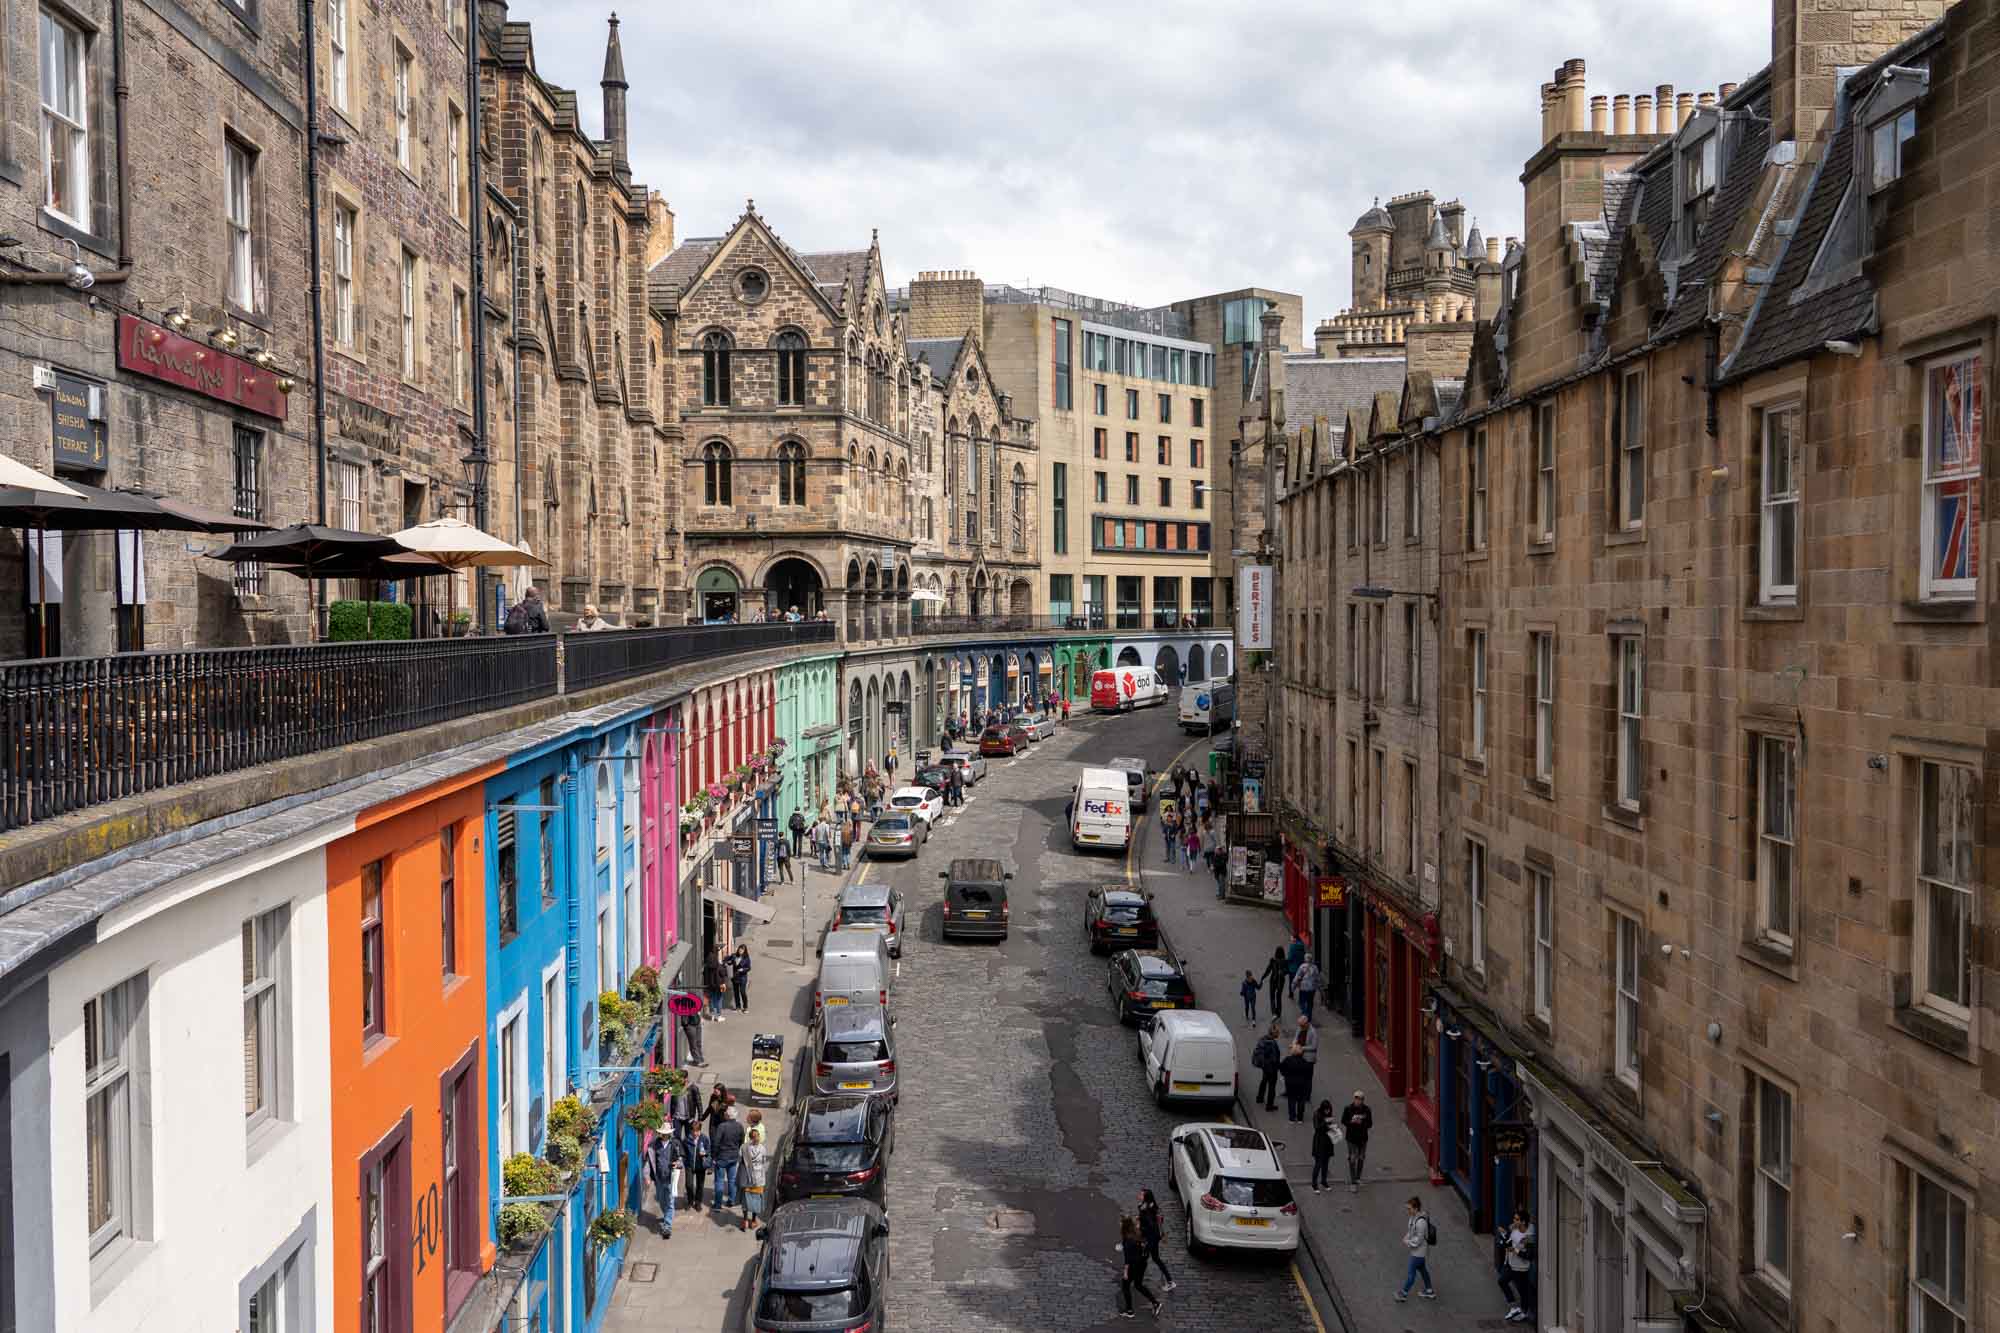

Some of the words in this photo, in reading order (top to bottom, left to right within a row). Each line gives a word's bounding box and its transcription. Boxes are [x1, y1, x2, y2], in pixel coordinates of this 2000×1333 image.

[57, 412, 86, 431] SHISHA
[57, 435, 89, 453] TERRACE
[1137, 674, 1150, 690] dpd
[1084, 800, 1122, 814] FedEx
[409, 1182, 439, 1276] 40
